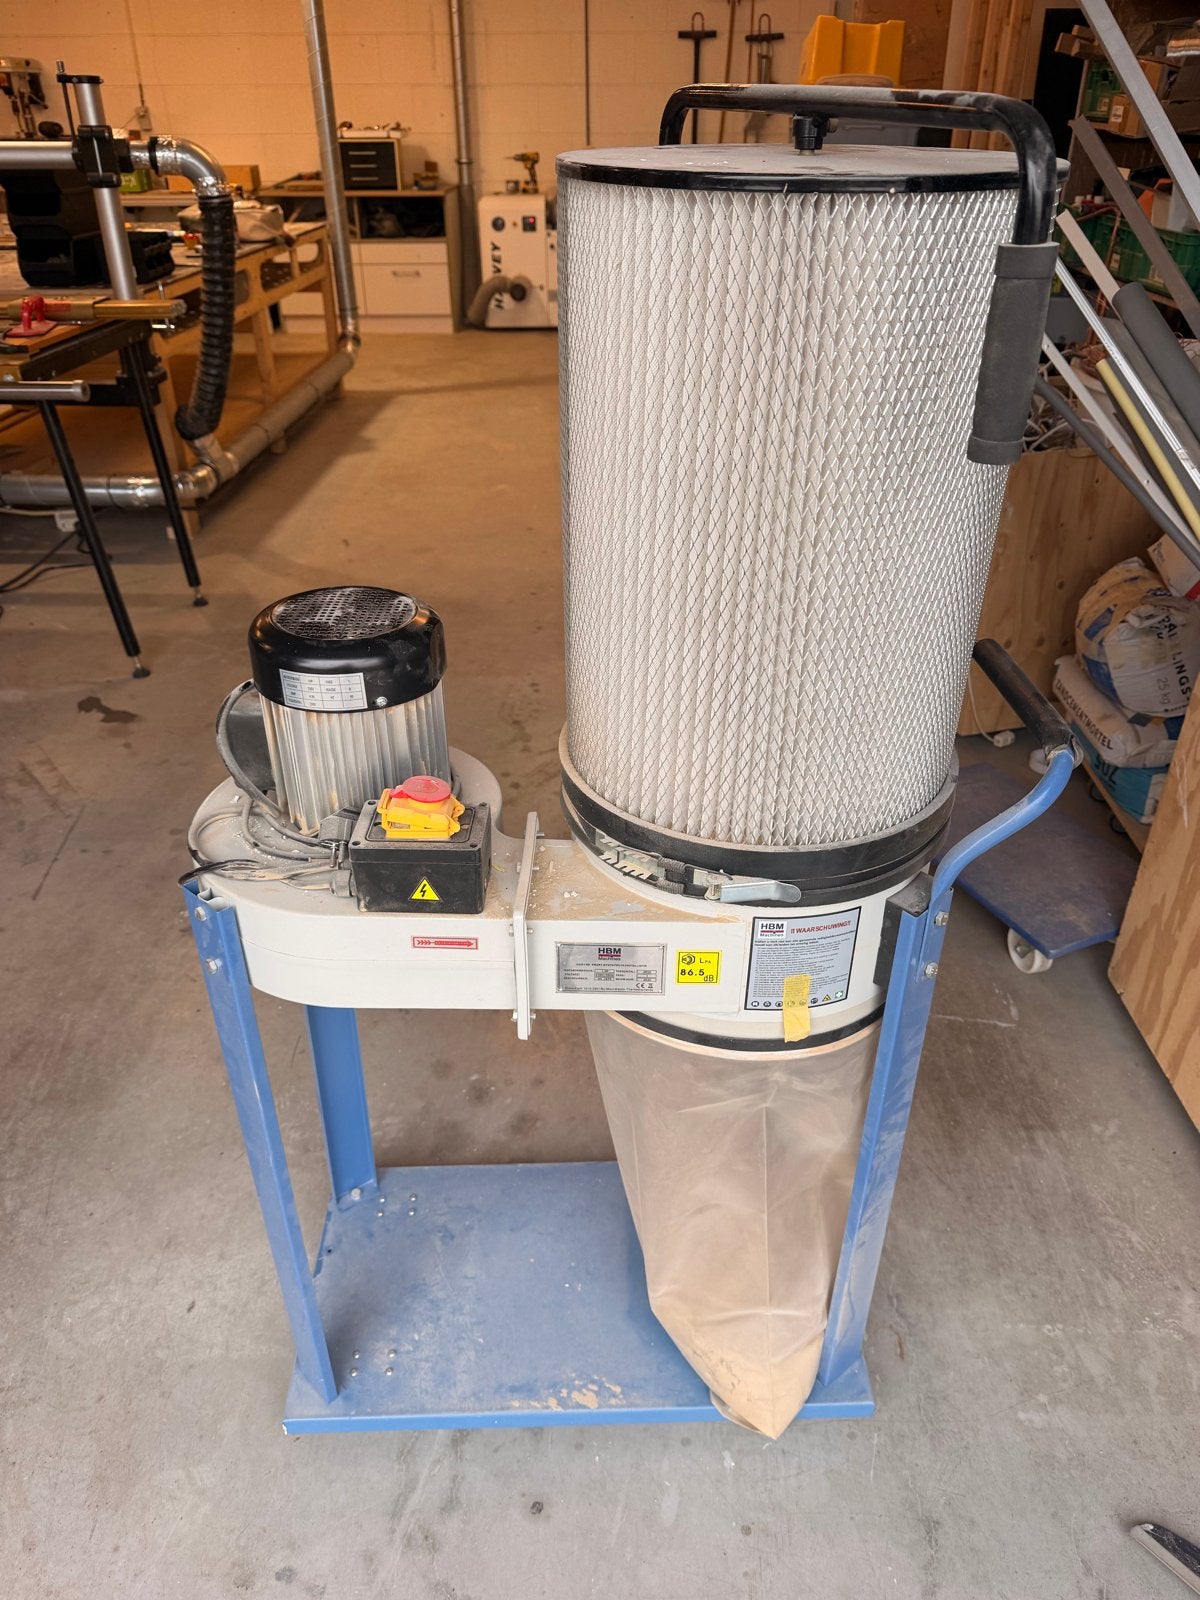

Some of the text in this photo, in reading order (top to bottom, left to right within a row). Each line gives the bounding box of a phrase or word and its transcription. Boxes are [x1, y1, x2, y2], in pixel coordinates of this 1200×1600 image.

[491, 242, 503, 310] HVEY
[1055, 678, 1114, 750] ZANDCEMENTMORTEL
[680, 968, 705, 976] 86.5
